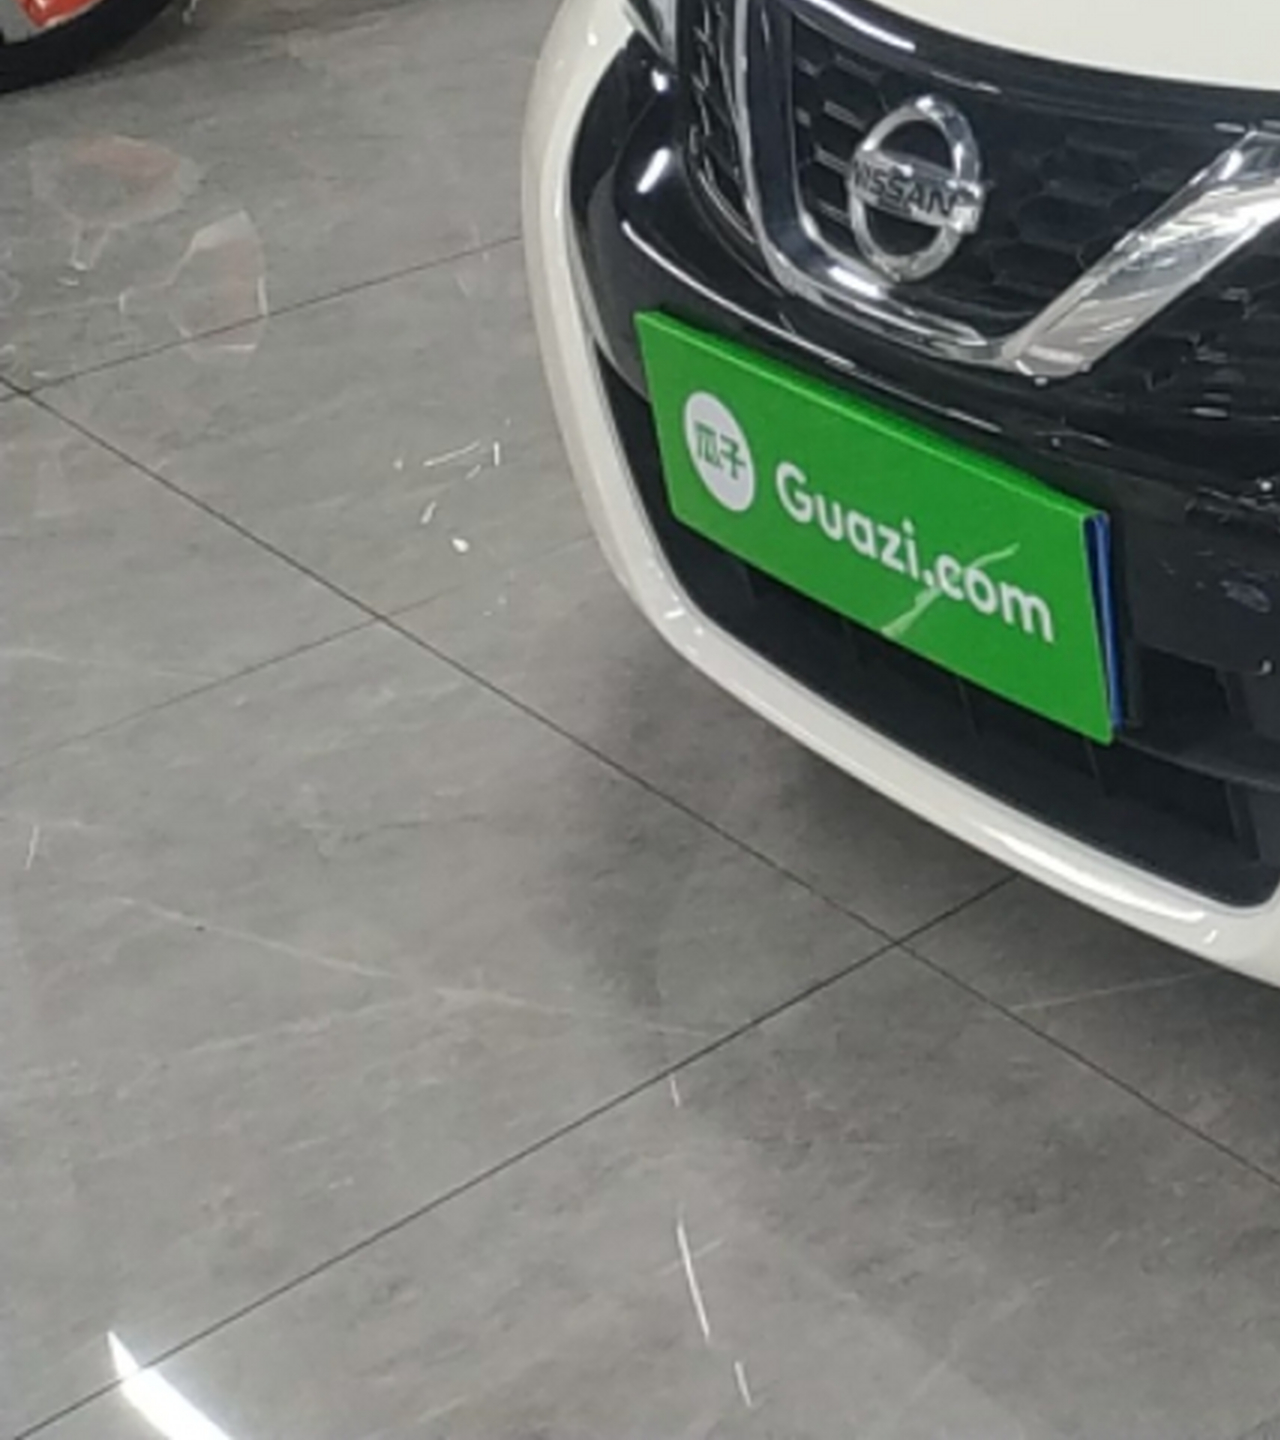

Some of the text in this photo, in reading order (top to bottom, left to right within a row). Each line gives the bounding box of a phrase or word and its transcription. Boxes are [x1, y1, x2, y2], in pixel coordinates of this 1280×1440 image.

[853, 159, 957, 216] NISSAN
[693, 420, 747, 481] 瓜子
[775, 461, 1054, 644] Guazi.com
